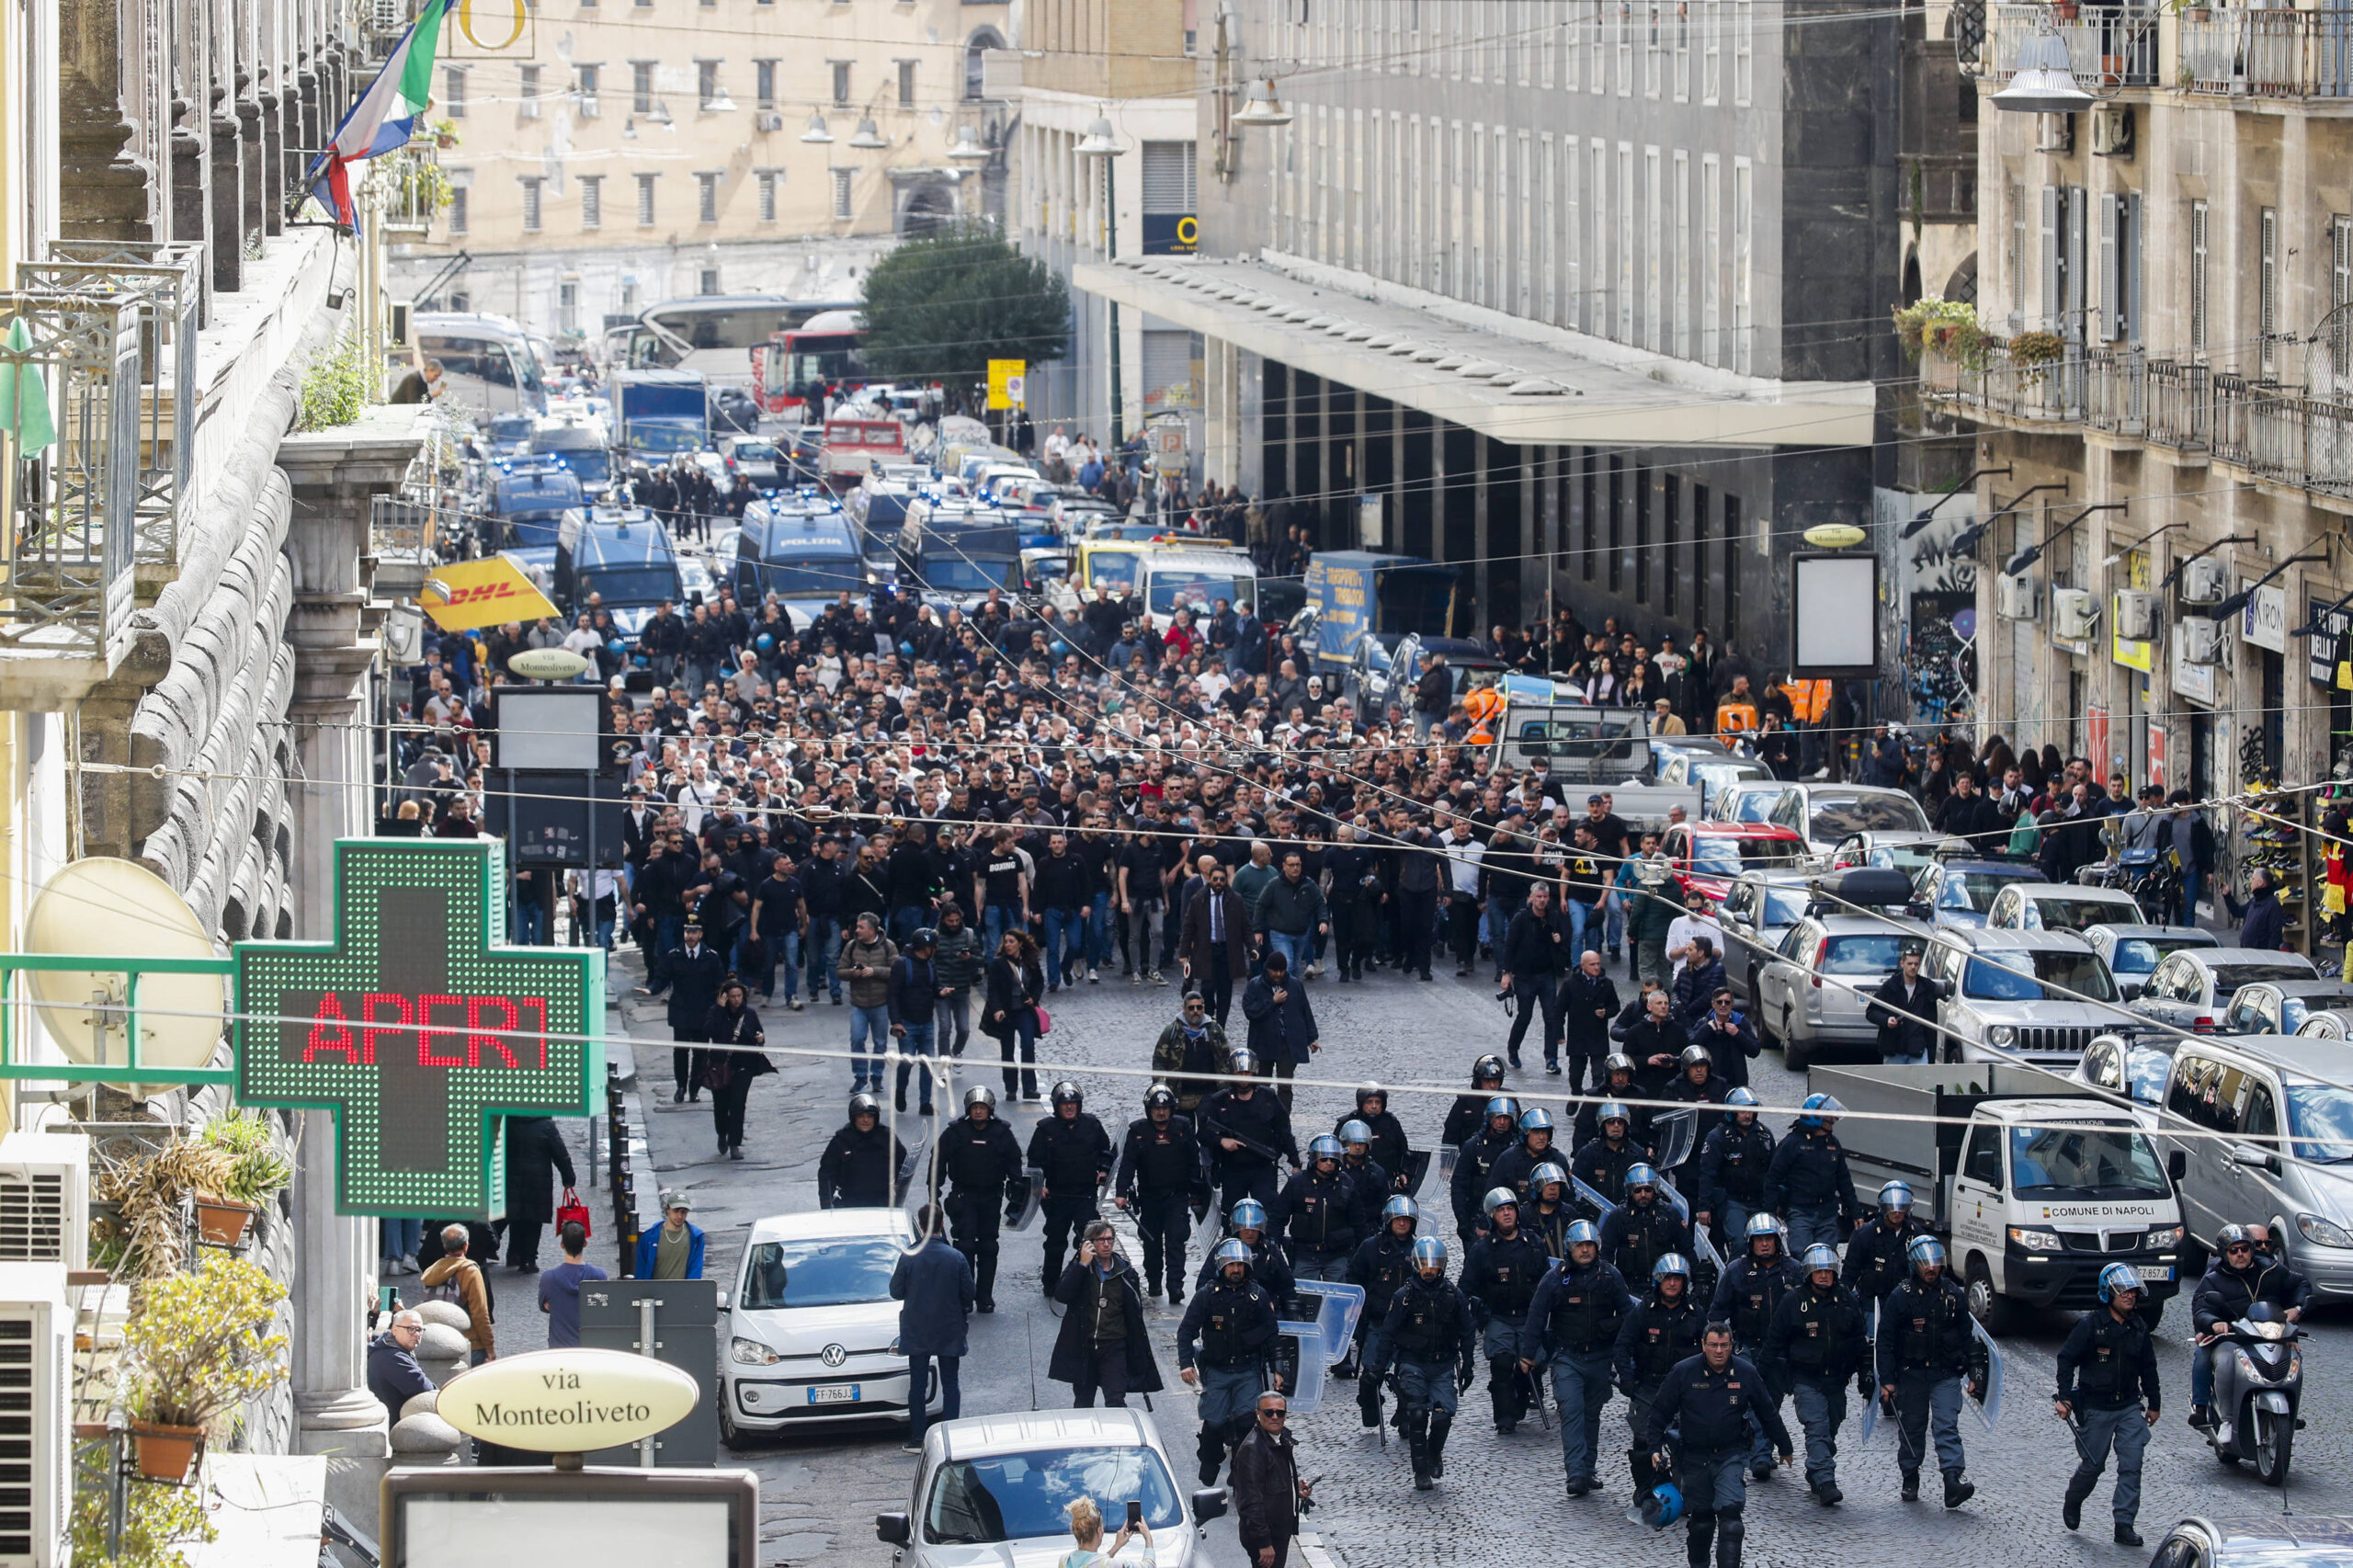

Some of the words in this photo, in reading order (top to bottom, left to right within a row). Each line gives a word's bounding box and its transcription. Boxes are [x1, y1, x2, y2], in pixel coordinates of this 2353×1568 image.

[780, 537, 843, 548] POLIZIA
[447, 582, 517, 606] DHL
[520, 663, 576, 671] Monteoliveto
[989, 861, 1016, 872] BOXING
[2052, 1207, 2099, 1217] COMUNE
[2100, 1206, 2113, 1216] DI
[2115, 1206, 2155, 1216] NAPOLI
[541, 1368, 581, 1390] via
[475, 1401, 651, 1426] Monteoliveto
